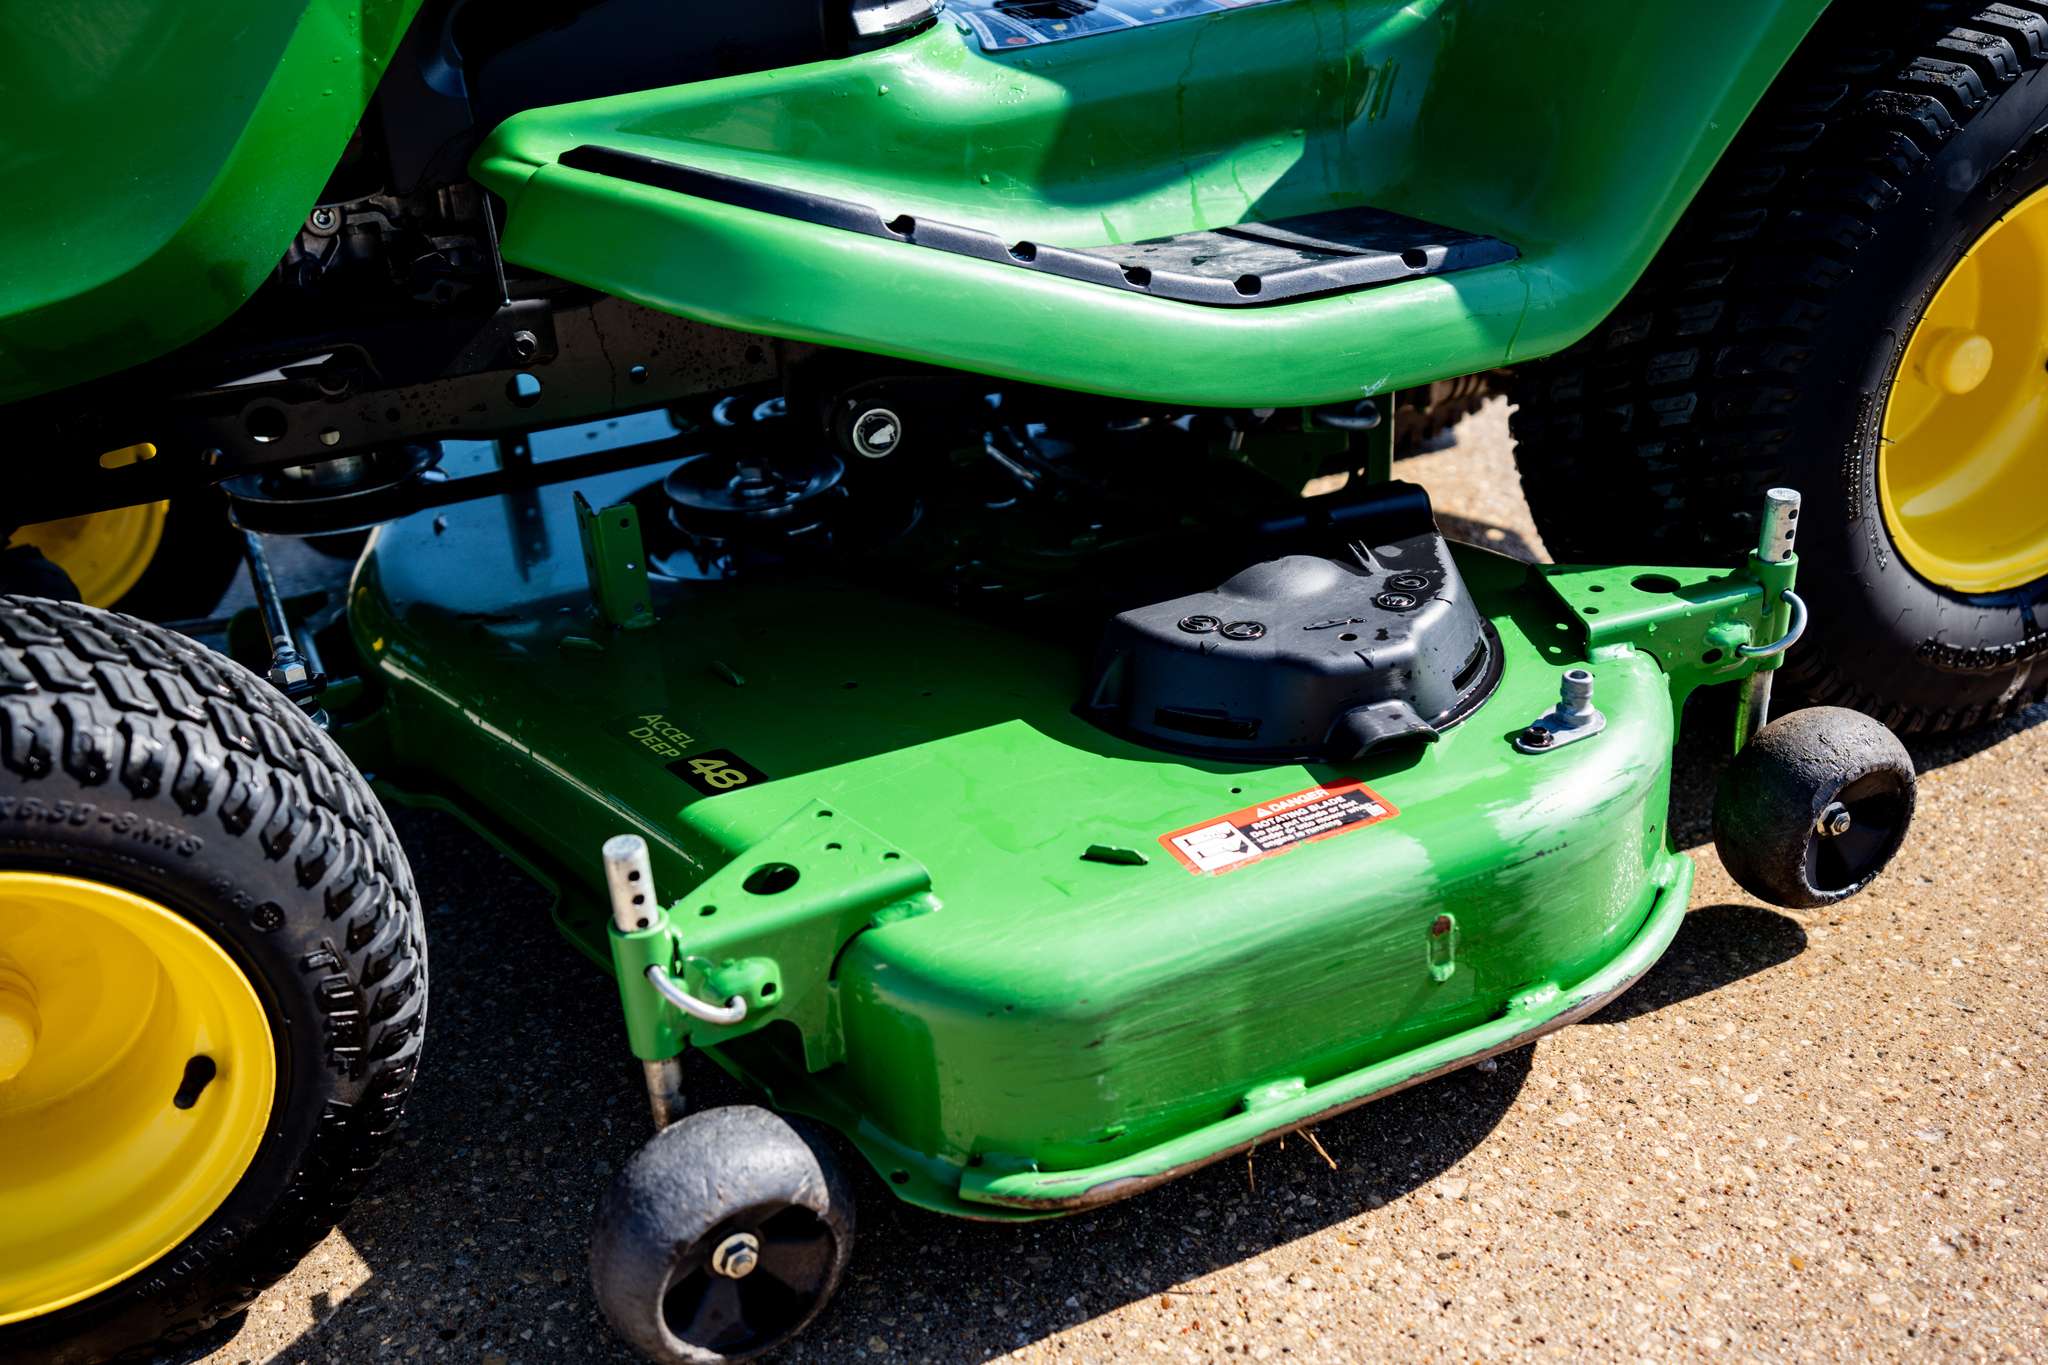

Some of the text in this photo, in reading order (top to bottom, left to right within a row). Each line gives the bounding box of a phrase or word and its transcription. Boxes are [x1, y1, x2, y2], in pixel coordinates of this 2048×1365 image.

[628, 726, 681, 757] DEEP
[638, 714, 695, 749] ACCEL
[687, 758, 748, 788] 48
[1251, 796, 1347, 830] ROTATING BLADE
[1267, 788, 1330, 812] DANGER
[1249, 830, 1266, 838] Do
[1265, 823, 1284, 833] not
[1282, 818, 1300, 829] put
[1297, 808, 1329, 821] hands
[1256, 831, 1285, 843] under
[1296, 820, 1316, 831] into
[1315, 811, 1347, 824] mower
[1346, 802, 1373, 814] when
[1262, 834, 1296, 849] engine
[1305, 819, 1343, 834] running
[302, 936, 362, 1081] TURF
